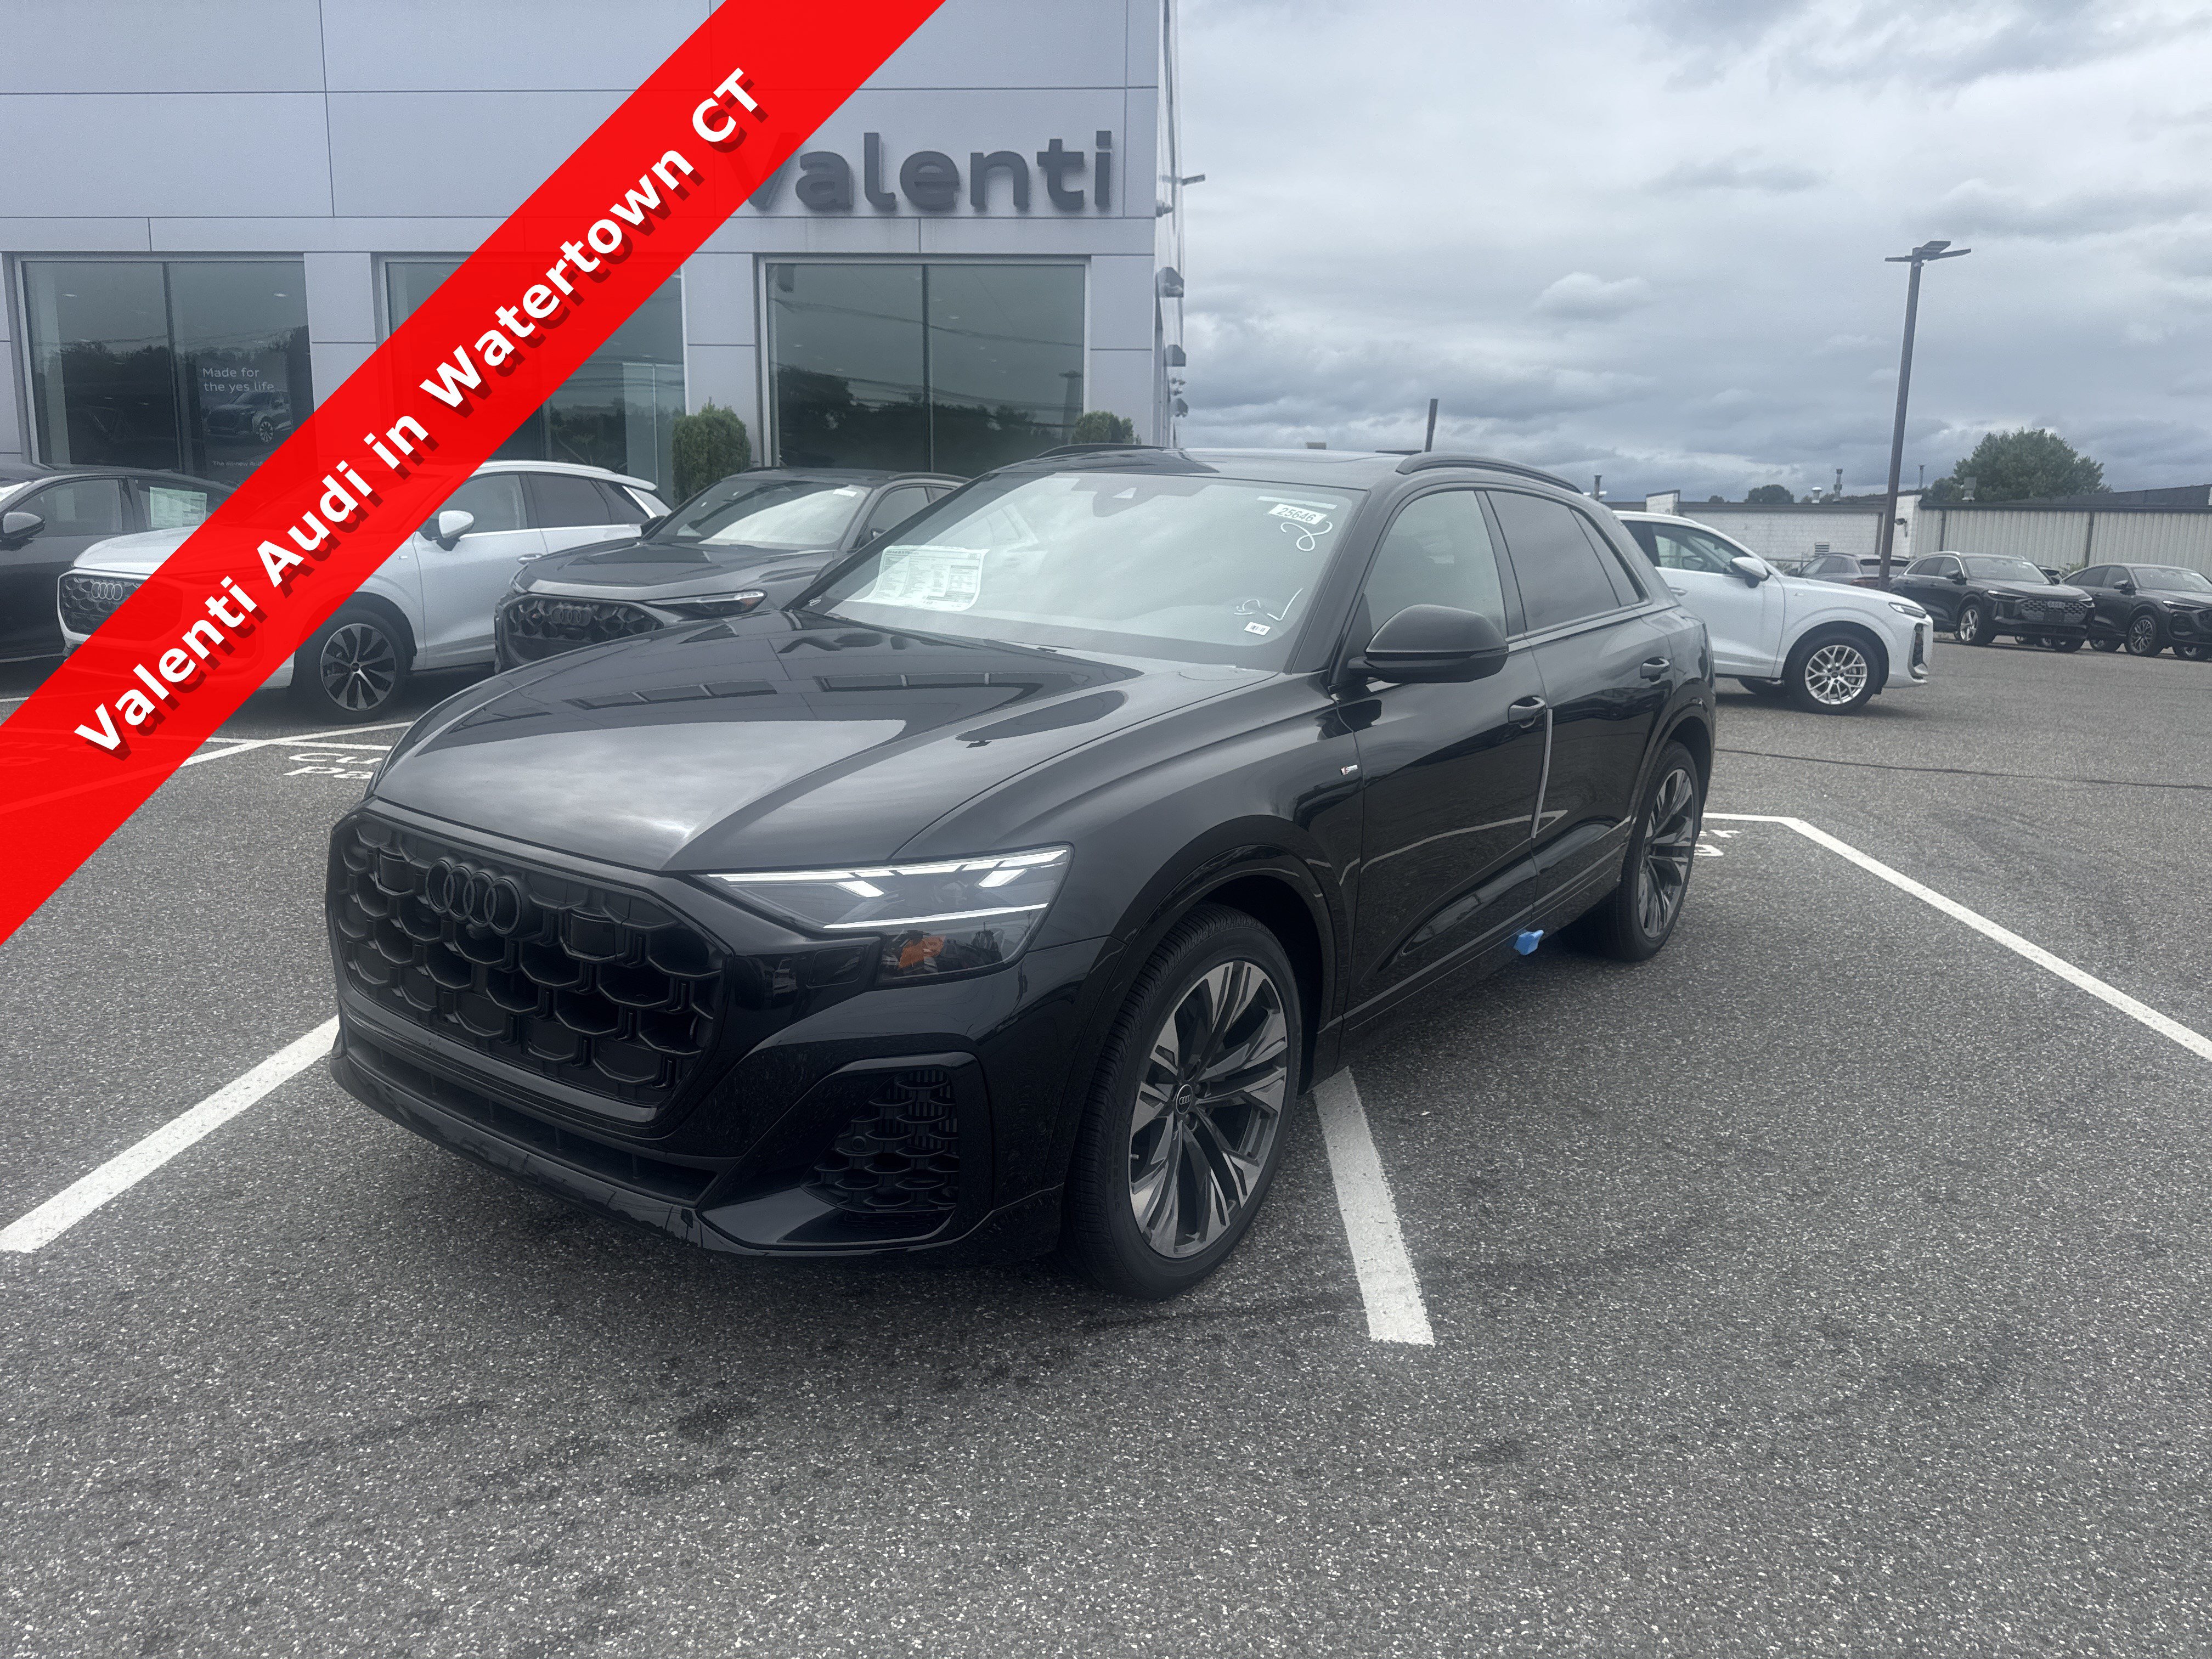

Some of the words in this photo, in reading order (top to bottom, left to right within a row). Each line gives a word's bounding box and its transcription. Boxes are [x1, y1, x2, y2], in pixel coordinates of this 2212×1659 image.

[202, 368, 236, 377] Made
[241, 368, 259, 377] for
[204, 382, 225, 392] the
[229, 383, 250, 393] yes
[255, 381, 274, 391] life
[1277, 507, 1317, 521] 25646
